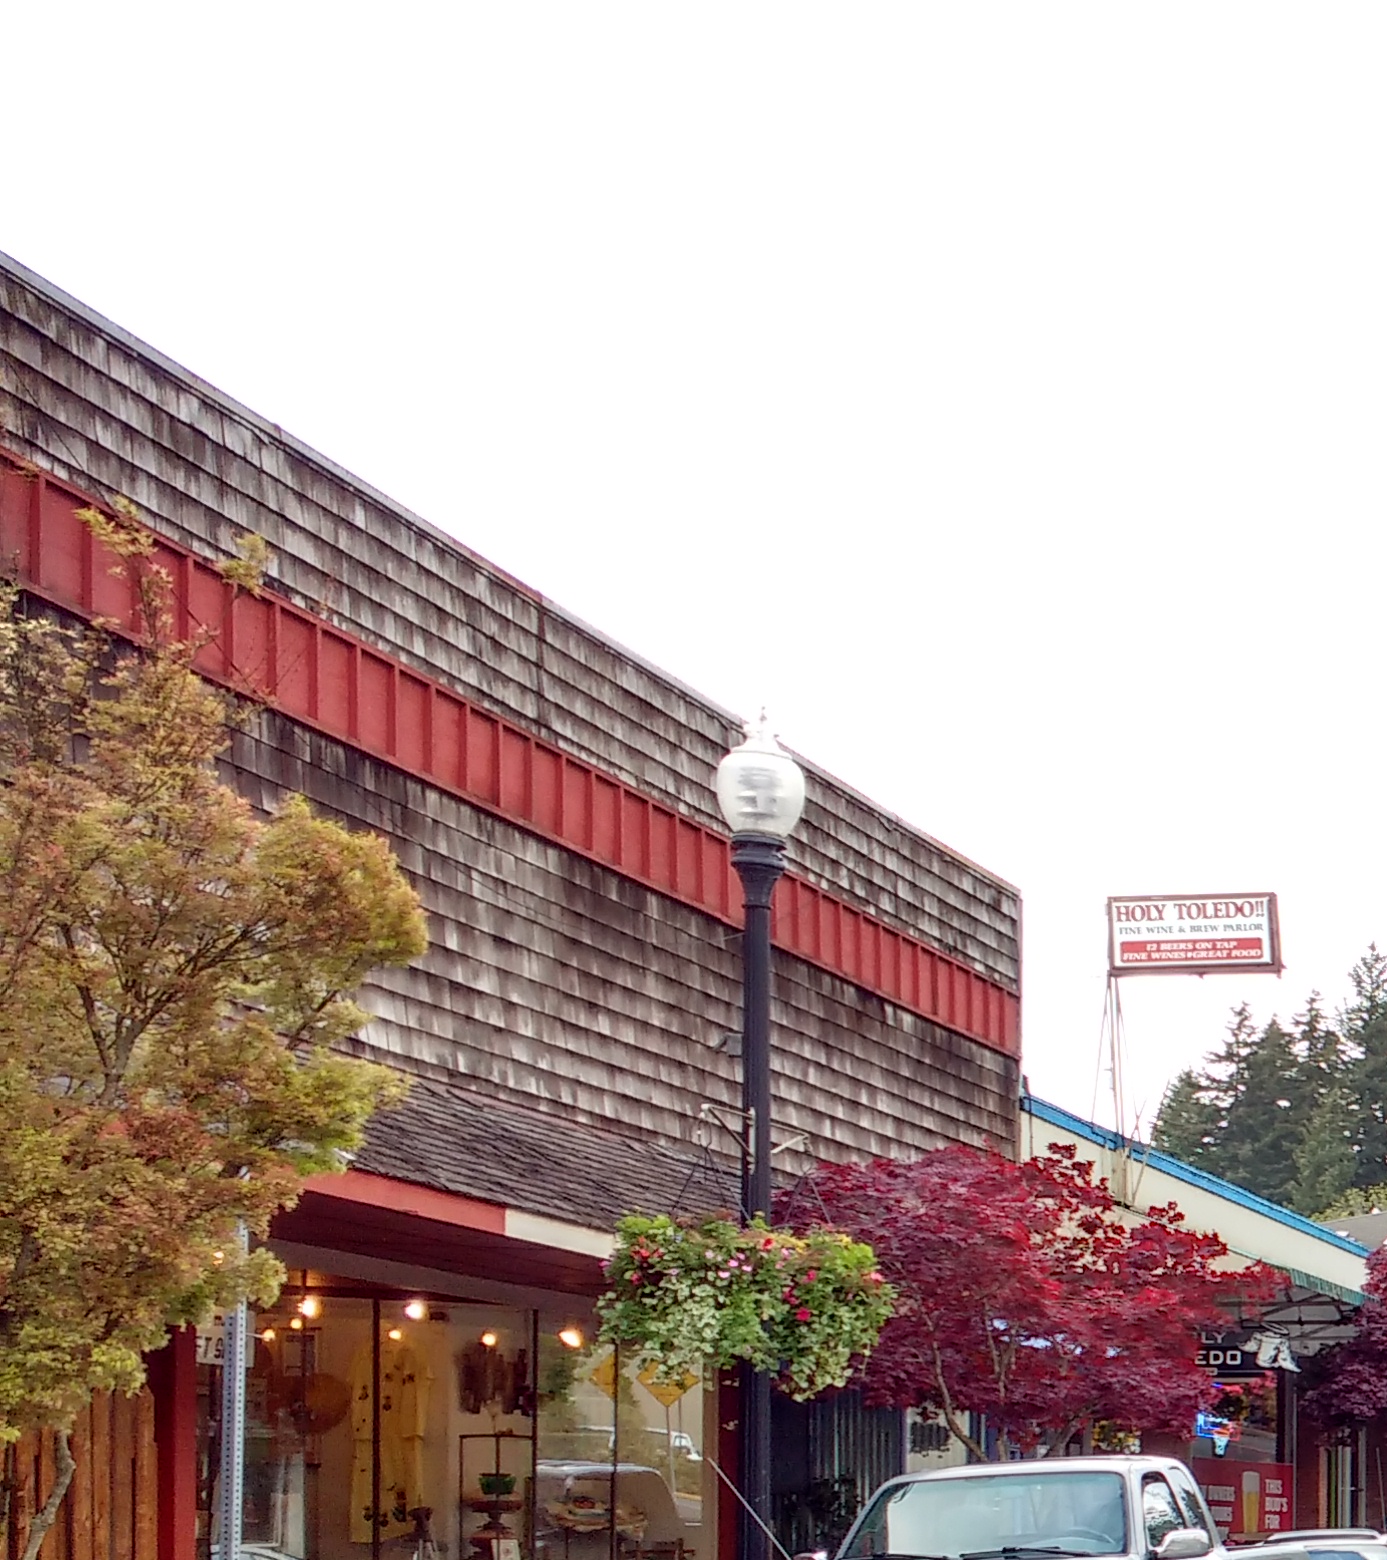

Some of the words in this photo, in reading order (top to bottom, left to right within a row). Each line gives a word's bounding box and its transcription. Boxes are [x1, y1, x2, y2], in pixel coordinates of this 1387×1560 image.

[1115, 903, 1167, 922] HOLY
[1173, 900, 1265, 920] TOLEDO!!
[1119, 926, 1143, 935] FINE
[1146, 926, 1174, 934] WINE
[1178, 925, 1186, 933] &
[1190, 924, 1220, 933] BREW
[1223, 923, 1264, 932] PARLOR
[1160, 942, 1193, 951] BEERS
[1195, 941, 1213, 950] ON
[1215, 940, 1237, 949] TAP
[1122, 952, 1148, 960] FINE
[1231, 949, 1262, 958] FOOD
[1265, 1479, 1282, 1494] THIS
[1264, 1514, 1280, 1529] FOR
